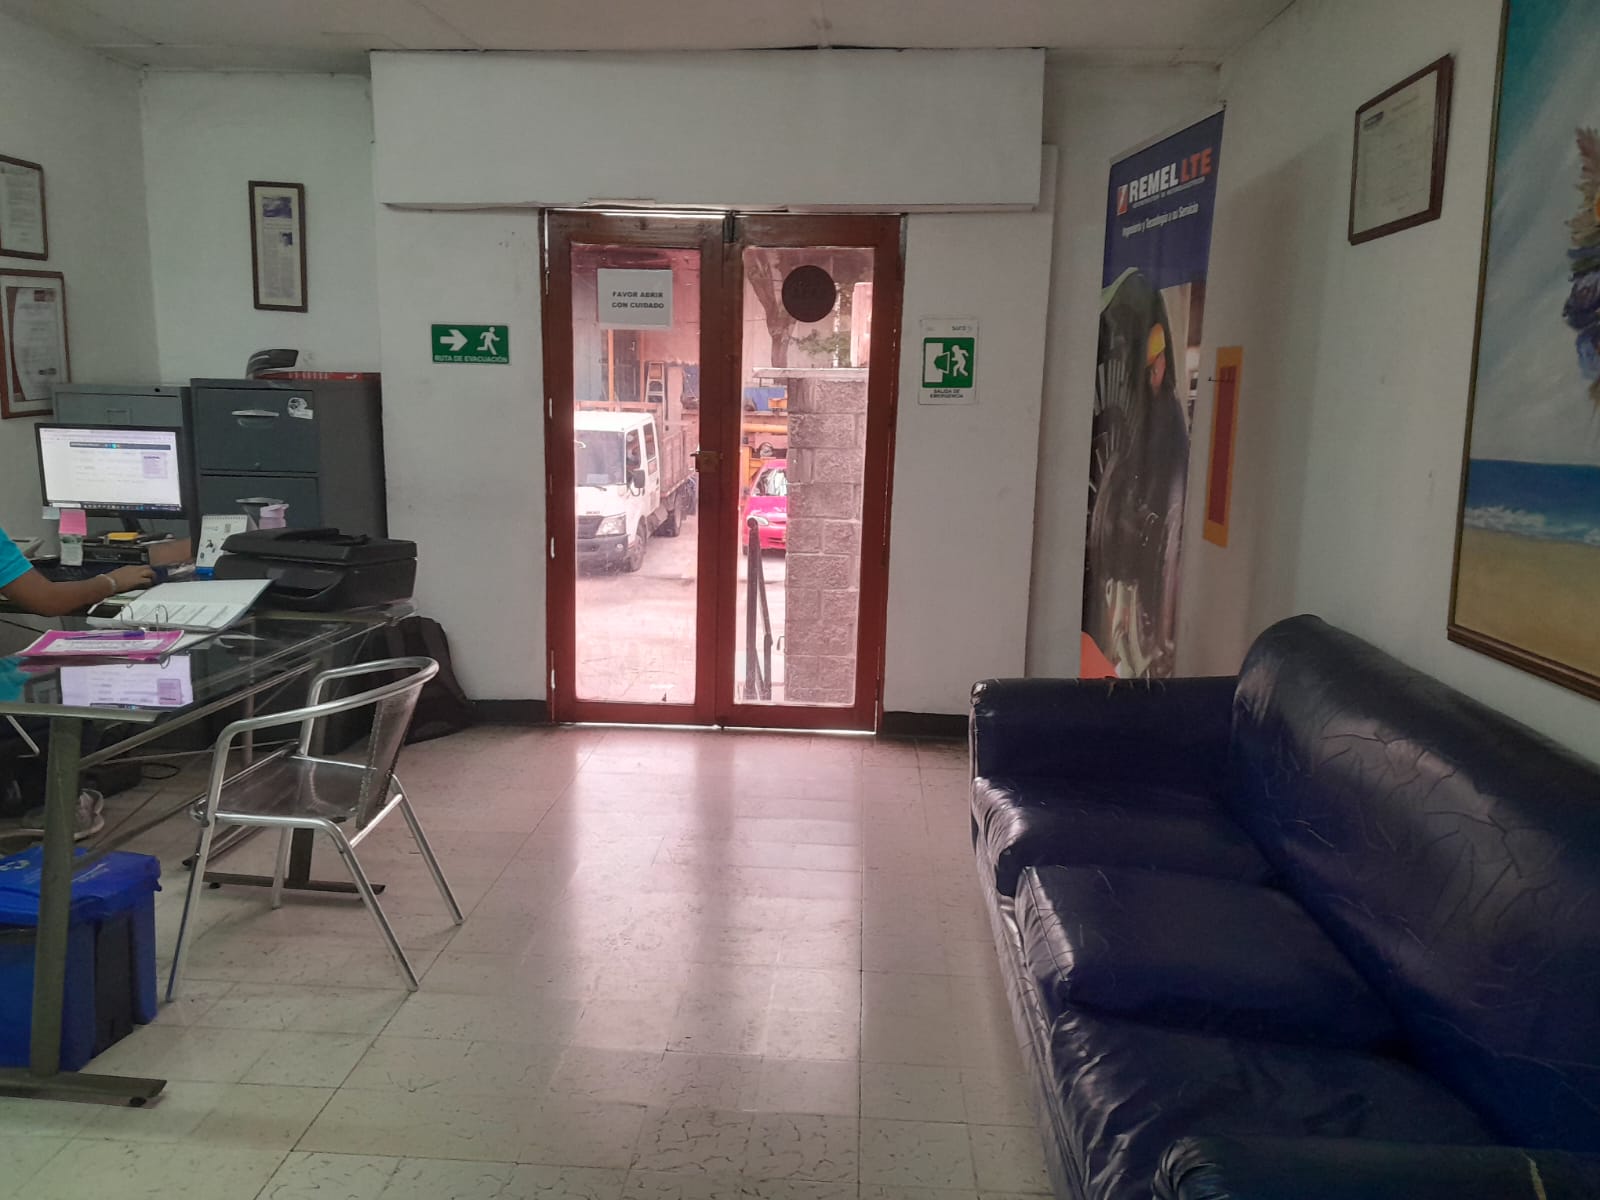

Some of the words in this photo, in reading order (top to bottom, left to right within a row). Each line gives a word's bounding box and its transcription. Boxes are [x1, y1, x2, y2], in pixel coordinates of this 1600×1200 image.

[1128, 162, 1179, 203] REMEL
[1181, 147, 1213, 185] LTE
[434, 354, 452, 362] RUTA
